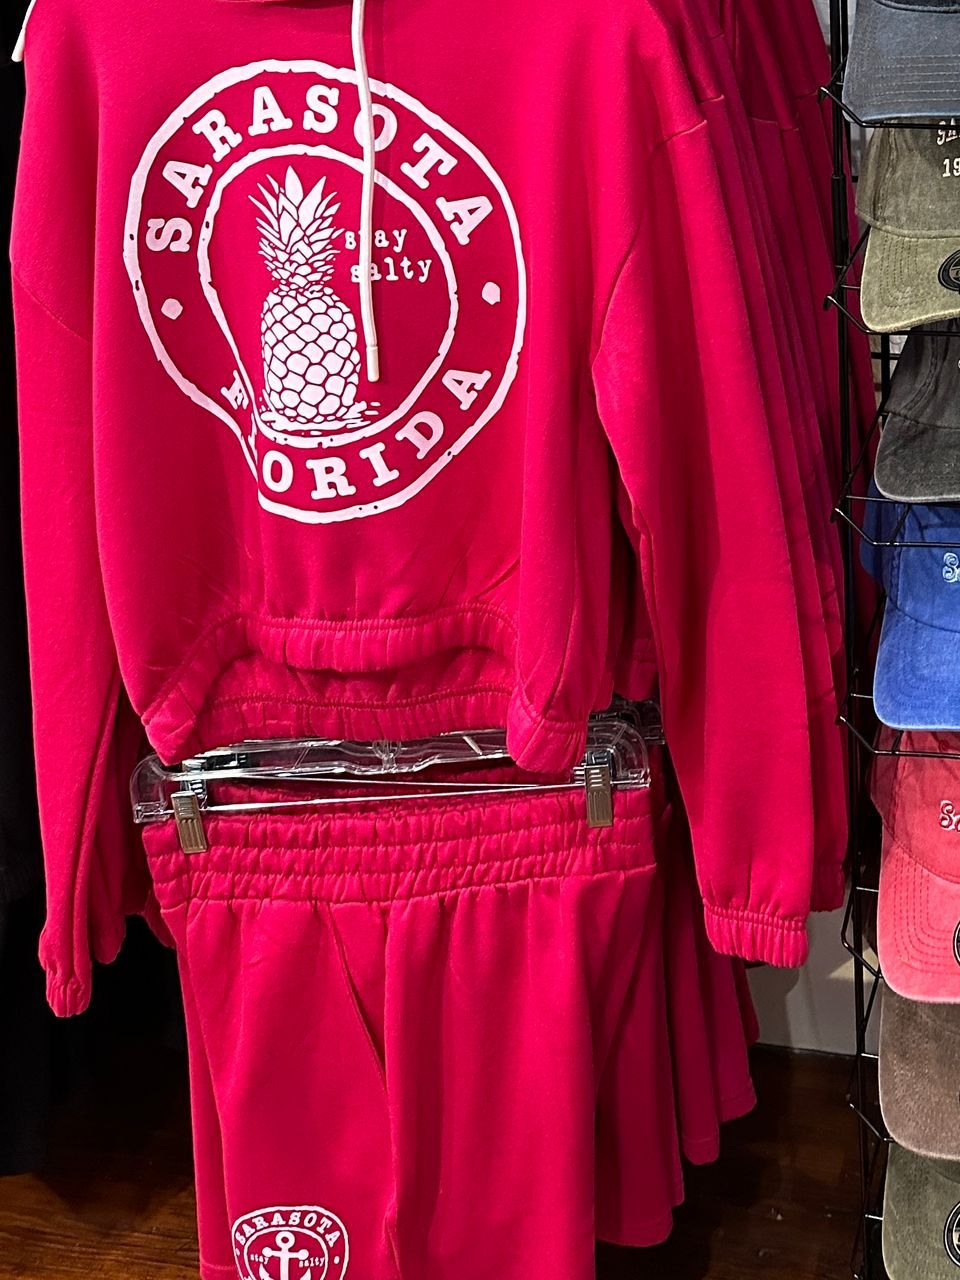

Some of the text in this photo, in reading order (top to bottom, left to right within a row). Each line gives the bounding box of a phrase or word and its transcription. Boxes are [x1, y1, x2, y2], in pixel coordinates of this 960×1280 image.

[146, 84, 494, 253] SARASOTA
[345, 228, 407, 253] say
[235, 1211, 341, 1248] SARASOTA
[299, 1257, 325, 1268] salty
